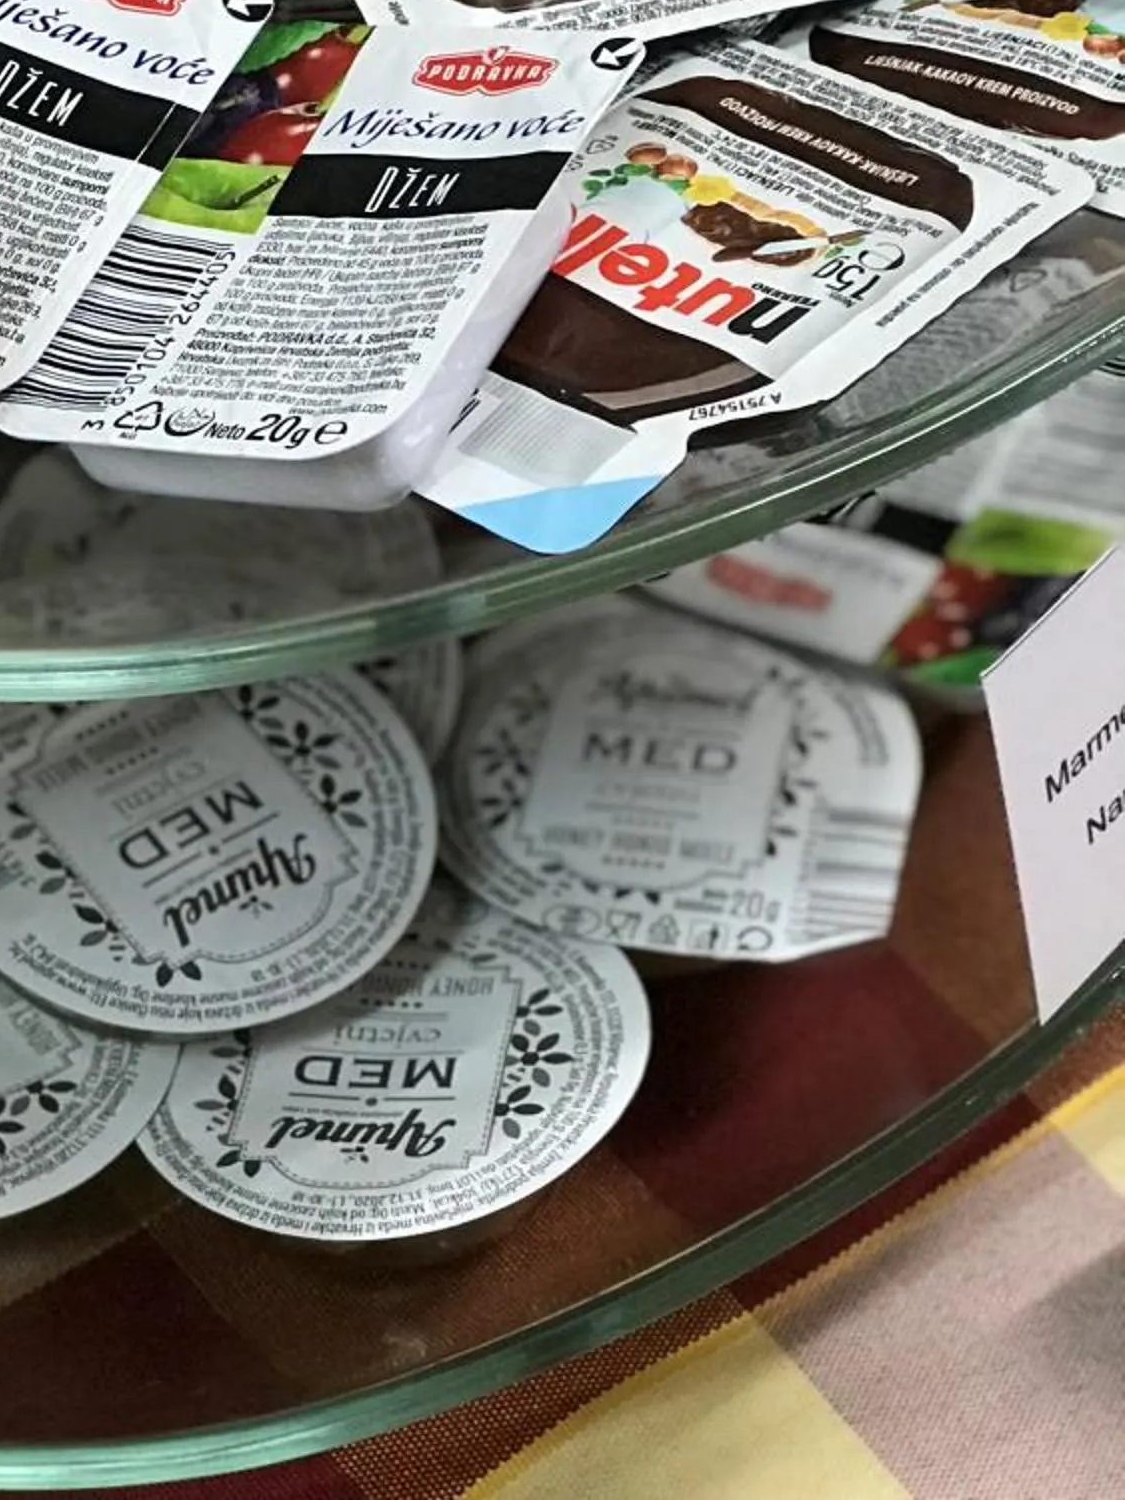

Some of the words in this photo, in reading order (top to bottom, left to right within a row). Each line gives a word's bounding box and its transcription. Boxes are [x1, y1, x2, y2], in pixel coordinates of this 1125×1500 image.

[133, 49, 217, 87] voće
[427, 60, 544, 83] PODRAVKA
[865, 55, 977, 86] LJEŠNJAK-KAKAOV
[974, 77, 1012, 96] KREM
[1011, 86, 1079, 115] PROIZVOD
[324, 106, 498, 149] Miješano
[507, 111, 586, 138] voće
[720, 97, 780, 131] PROIZVOD
[777, 124, 813, 143] KREM
[811, 138, 918, 185] LJEŠNJAK-KAKAOV
[364, 165, 461, 213] DŽEM
[552, 200, 802, 346] nutell
[811, 253, 880, 302] 15g
[108, 334, 173, 408] 850104
[170, 250, 236, 325] 264405
[688, 394, 768, 421] 75154767
[204, 421, 246, 443] Neto
[245, 413, 311, 449] 20g
[584, 733, 738, 775] MED
[118, 779, 267, 872] MED
[1086, 788, 1125, 846] Na
[162, 833, 317, 948] Apimel
[733, 894, 781, 922] 20g
[428, 975, 495, 996] HONEY
[333, 1023, 443, 1046] cvjetni
[294, 1054, 457, 1091] MED
[266, 1109, 459, 1160] Apimel
